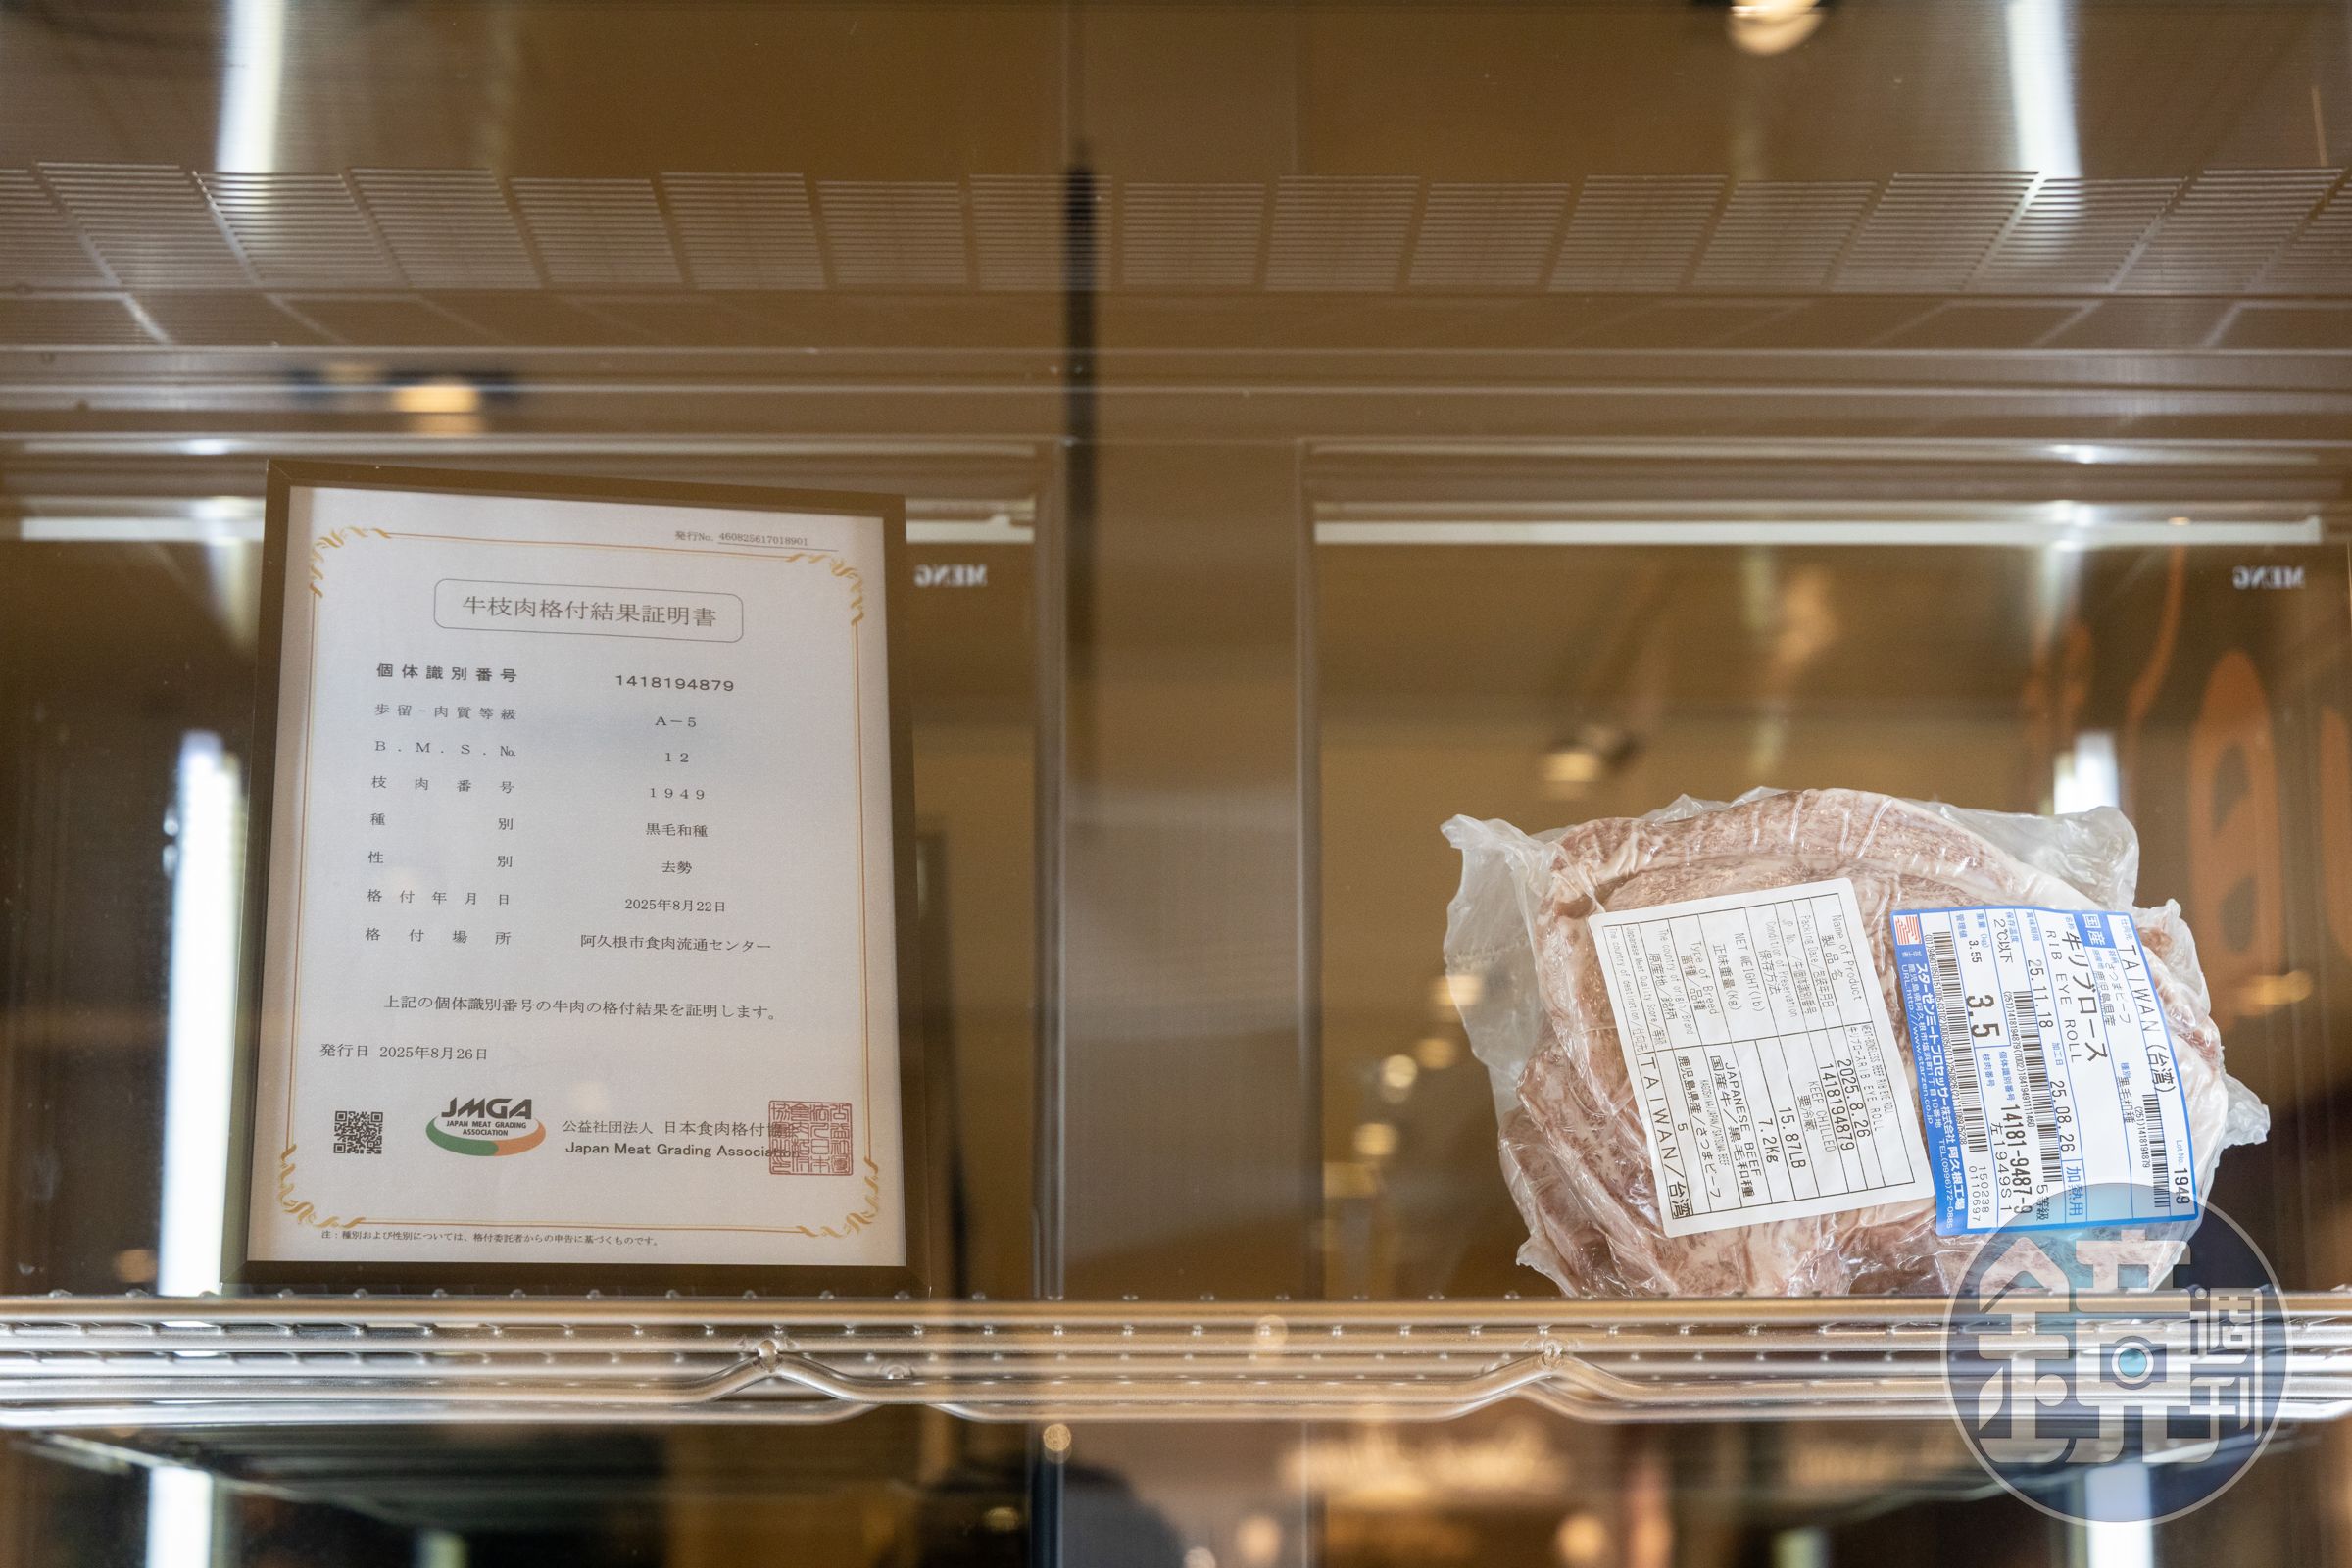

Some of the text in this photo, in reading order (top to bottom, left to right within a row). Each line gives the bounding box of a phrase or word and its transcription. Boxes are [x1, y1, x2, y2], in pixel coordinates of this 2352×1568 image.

[718, 532, 808, 546] 460825617018901
[463, 596, 716, 627] 牛枝肉格付結果証明書
[376, 663, 517, 683] 個体識別番号
[615, 674, 734, 692] 1418194879
[664, 752, 690, 763] 12
[649, 788, 706, 802] 1949
[645, 822, 709, 838] 黒毛和種
[662, 860, 693, 875] 去勢
[624, 899, 726, 913] 2025年8月22日
[580, 935, 771, 952] 阿久根市食肉流通センター
[1656, 928, 1670, 941] The
[1733, 932, 1747, 950] NET
[2005, 911, 2019, 942] 保存温度
[2082, 913, 2105, 945] 国産
[1660, 944, 1676, 971] country
[1820, 934, 1843, 981] 製品名
[1830, 914, 1863, 1001] Name of Product
[1968, 940, 1982, 962] 3.55
[1669, 973, 1681, 982] of
[1689, 941, 1720, 1015] Type of Breed
[1757, 949, 1781, 995] 保存方法
[1764, 921, 1799, 1017] Condition of Preservation
[2025, 911, 2054, 1028] 賞味期限 25.11.18
[2045, 930, 2082, 1062] RIB EYE ROLL
[2060, 931, 2108, 1061] 牛リブロース
[2092, 970, 2116, 1026] 鹿児島県産
[2104, 962, 2131, 1023] さつまビーフ
[2118, 945, 2160, 1031] TAIWAN
[383, 994, 777, 1021] 上記の個体識別番号の牛肉の格付結果を証明します。
[1964, 994, 1999, 1038] 3.5
[320, 1043, 489, 1061] 発行日 2025年8月26日
[1916, 962, 1967, 1210] スターゼンミートプロセッサー株式会社 阿久根工場
[1981, 1054, 1995, 1087] 枝肉番号
[441, 1097, 532, 1119] JMGA
[1818, 1062, 1855, 1151] 1418194879
[1837, 1058, 1871, 1138] 2025.8.26
[1863, 1085, 1877, 1102] EYE
[2049, 1042, 2075, 1152] 加工日 25.08.26
[2114, 1076, 2137, 1123] 黒毛和種
[563, 1120, 654, 1135] 公益社団法人
[1676, 1122, 1688, 1132] 5
[1723, 1061, 1762, 1177] JAPANESE BEEF
[1796, 1094, 1818, 1131] 要冷蔵
[1807, 1080, 1837, 1152] KEEP CHILLED
[1869, 1107, 1885, 1131] ROLL
[463, 1128, 508, 1137] ASSOCIATION
[1756, 1117, 1783, 1163] 7.2Kg
[1777, 1106, 1806, 1169] 15.87LB
[1997, 1051, 2033, 1214] 個体識別番号 14181-9487-9
[2133, 1105, 2150, 1168] (251)1418194879
[2175, 1139, 2183, 1151] Lot
[565, 1142, 609, 1155] Japan
[614, 1143, 651, 1155] Meat
[657, 1144, 711, 1158] Grading
[1968, 1166, 1980, 1221] 0110697
[1977, 1166, 1989, 1213] 150238
[2065, 1165, 2083, 1216] 加熱用
[2173, 1167, 2190, 1203] 1949
